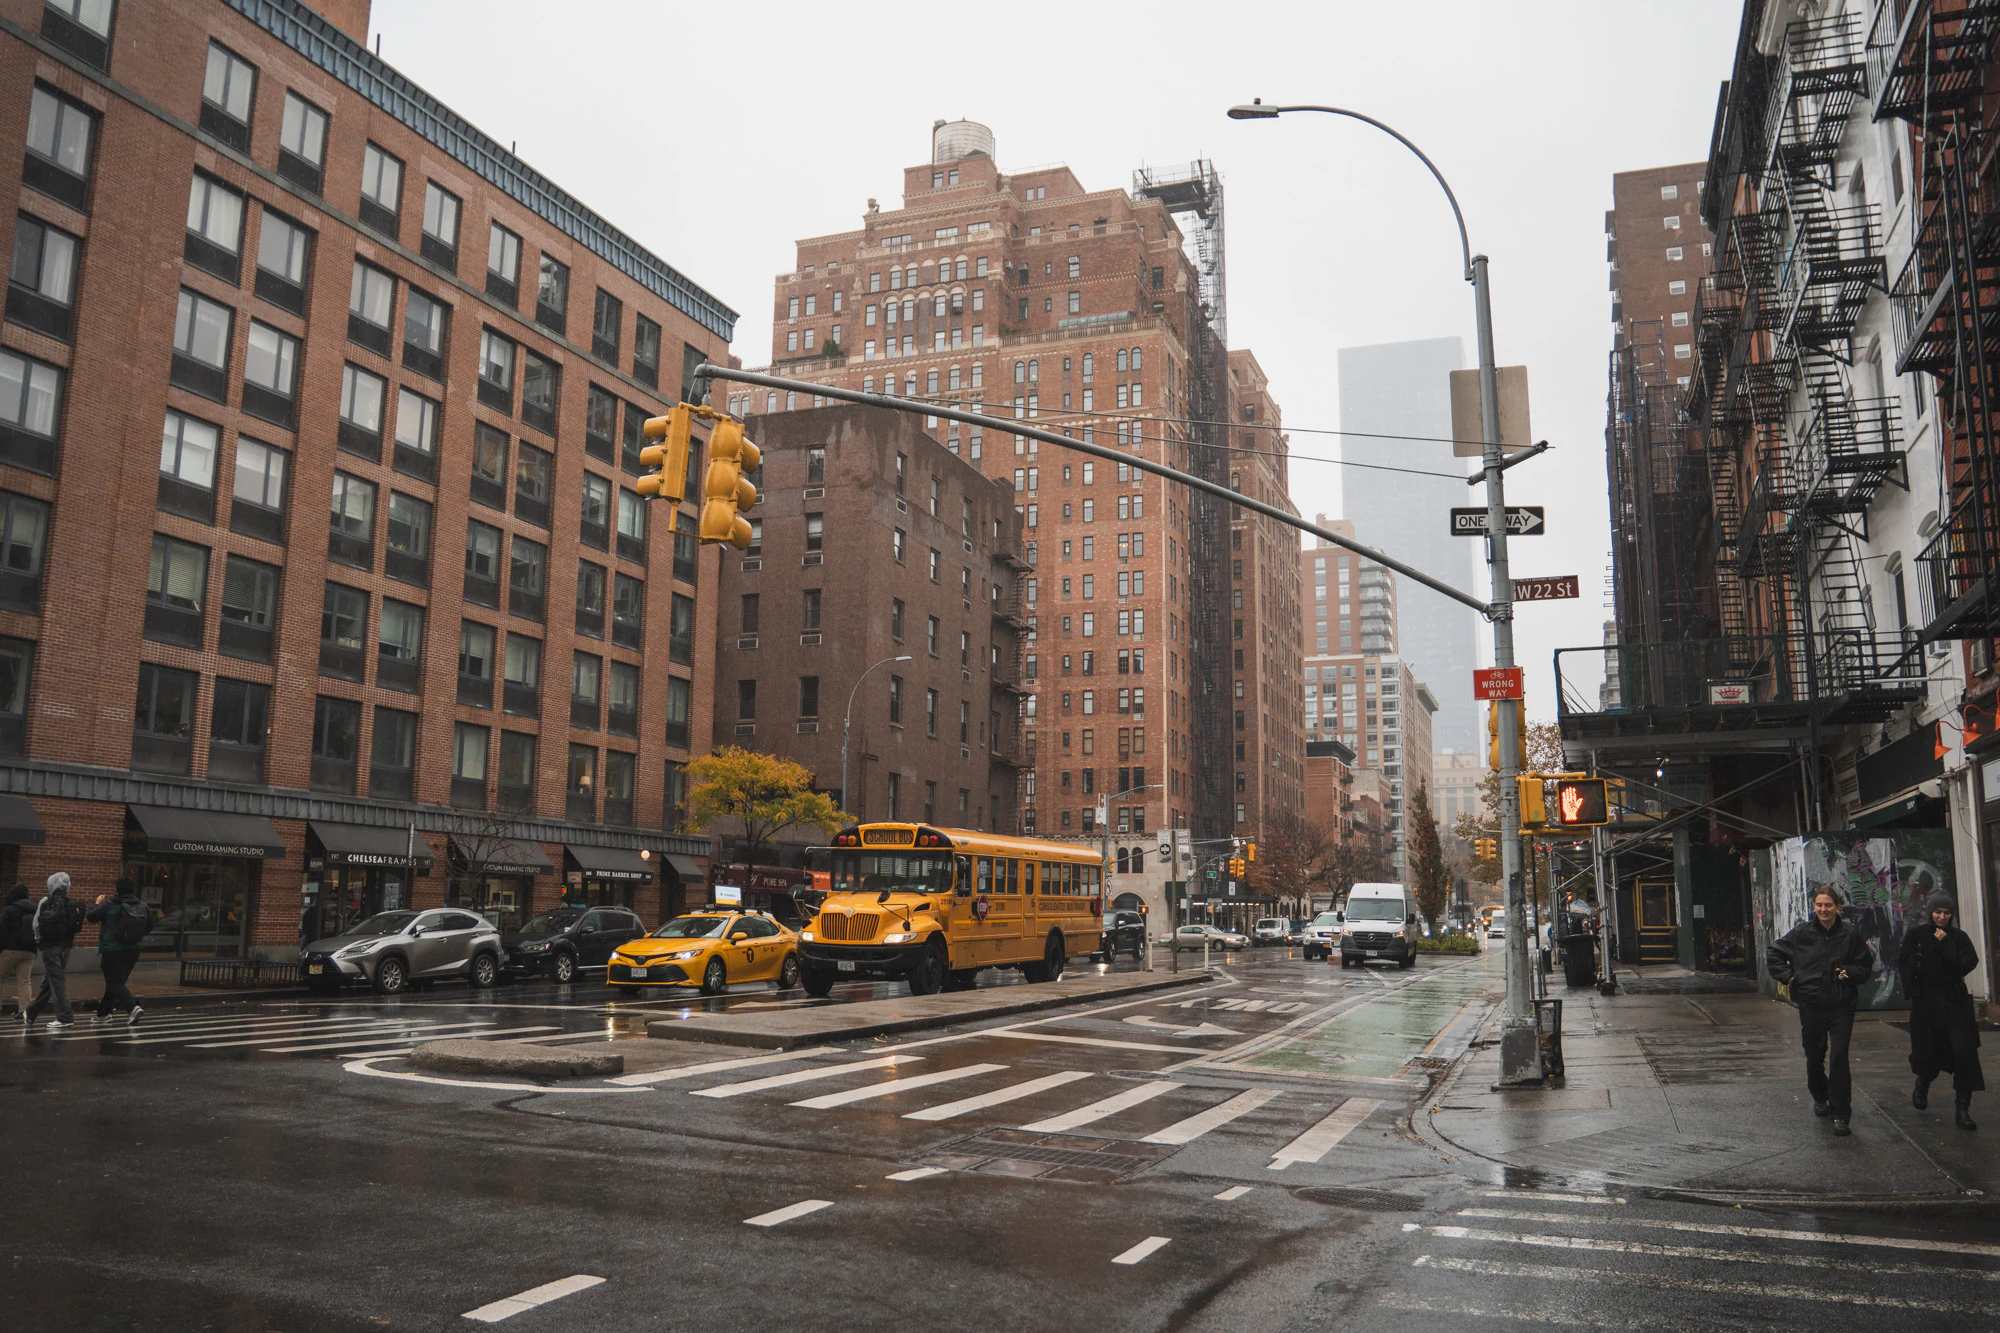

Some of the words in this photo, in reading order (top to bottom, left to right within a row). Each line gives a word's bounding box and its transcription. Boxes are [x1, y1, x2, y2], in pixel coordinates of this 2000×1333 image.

[1458, 516, 1486, 528] ONE
[1517, 584, 1532, 600] W
[1534, 583, 1552, 599] 22
[1556, 582, 1572, 597] St
[1481, 679, 1514, 689] WRONG
[1488, 689, 1507, 698] WAY
[869, 831, 897, 843] SCHOOL
[898, 831, 914, 843] BUS
[173, 842, 204, 852] CUSTOM
[206, 844, 239, 854] FRAMING
[240, 847, 265, 856] STUDIO
[763, 877, 777, 886] PURE
[777, 878, 788, 887] SPA
[979, 902, 988, 912] STOP
